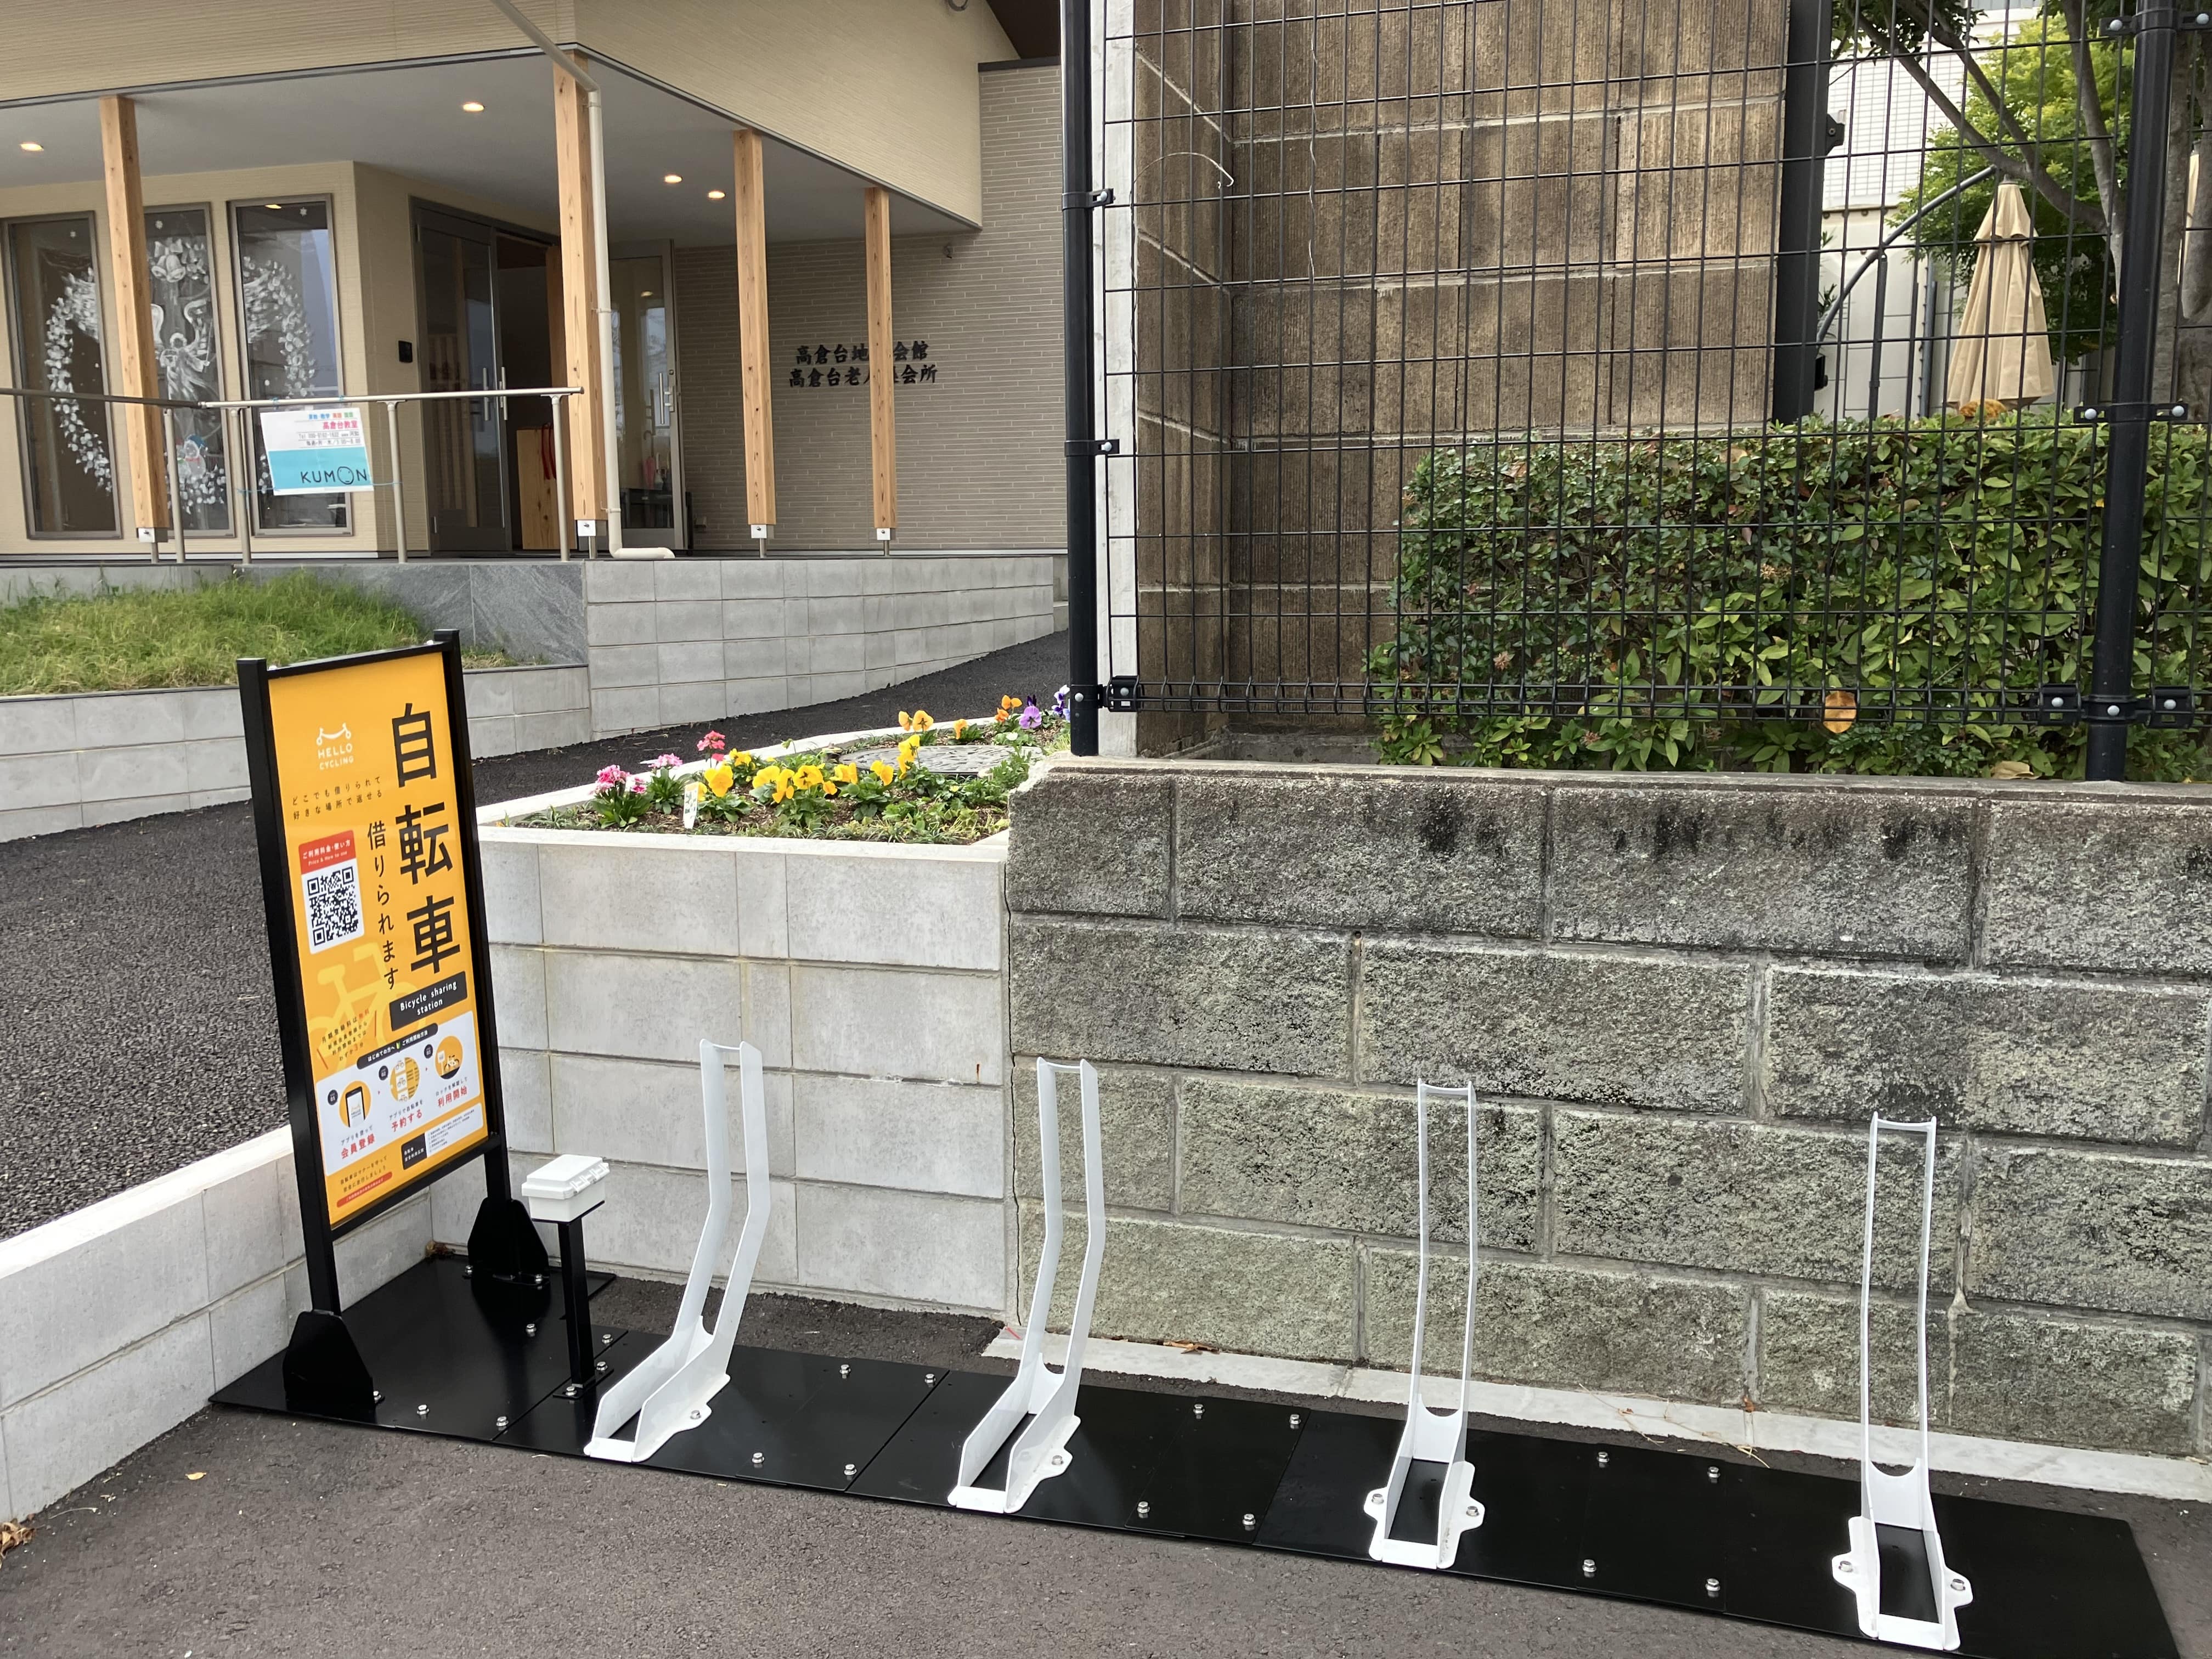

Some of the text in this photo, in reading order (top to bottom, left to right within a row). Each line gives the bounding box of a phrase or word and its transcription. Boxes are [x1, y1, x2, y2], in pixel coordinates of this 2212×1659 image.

[796, 340, 929, 365] 高倉台地会館
[789, 364, 938, 387] 高倉台老会所
[301, 466, 368, 485] KUMON
[318, 743, 353, 760] HELLO
[319, 755, 354, 770] CYCLING
[292, 776, 380, 806] どこでも借りられて
[293, 789, 382, 821] 好きな場所で返せる
[392, 703, 460, 974] 自転車
[368, 820, 399, 990] 借りられます
[400, 981, 457, 1012] Bicycle sharing
[417, 998, 443, 1015] station
[438, 1085, 468, 1108] 利用開始
[391, 1109, 422, 1133] 予約する
[341, 1133, 375, 1159] 会員登録
